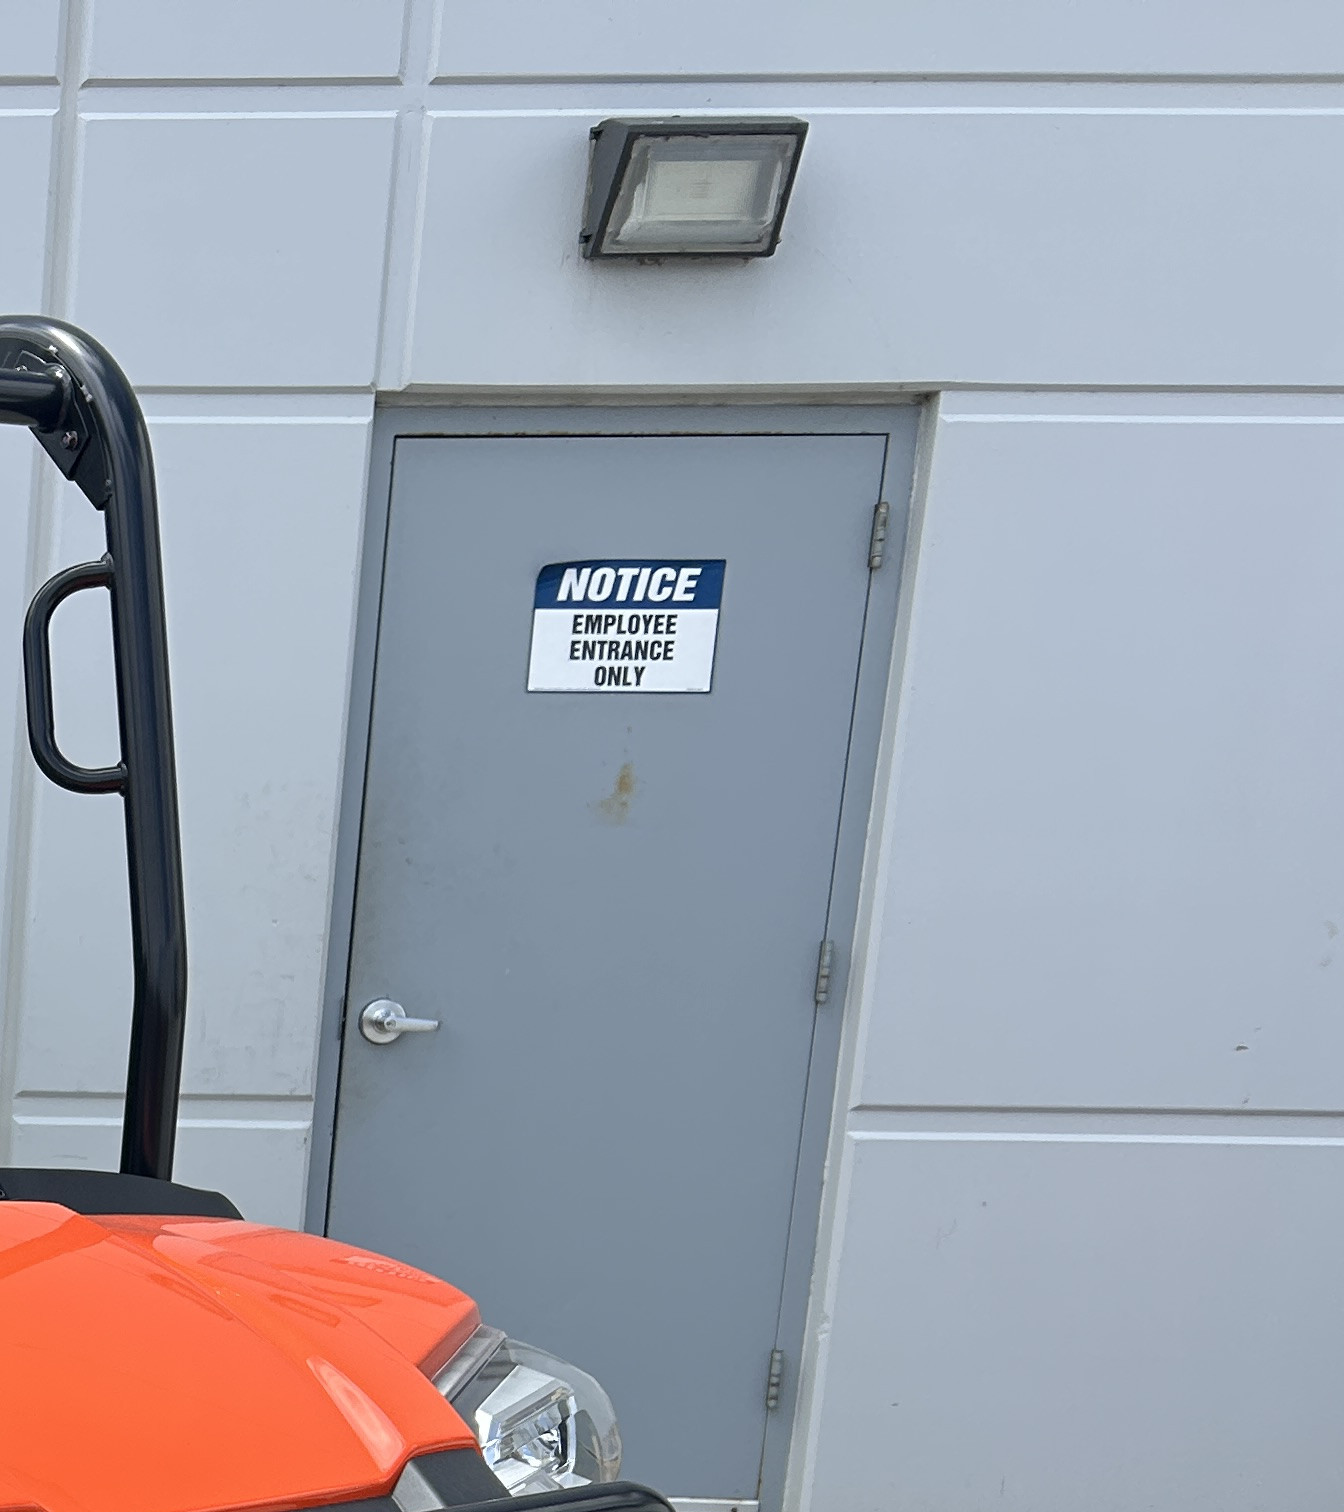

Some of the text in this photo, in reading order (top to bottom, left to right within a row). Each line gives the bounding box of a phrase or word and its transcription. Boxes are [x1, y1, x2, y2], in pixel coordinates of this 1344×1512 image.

[556, 567, 702, 602] NOTICE
[572, 614, 678, 635] EMPLOYEE
[569, 640, 675, 661] ENTRANCE
[594, 666, 646, 687] ONLY
